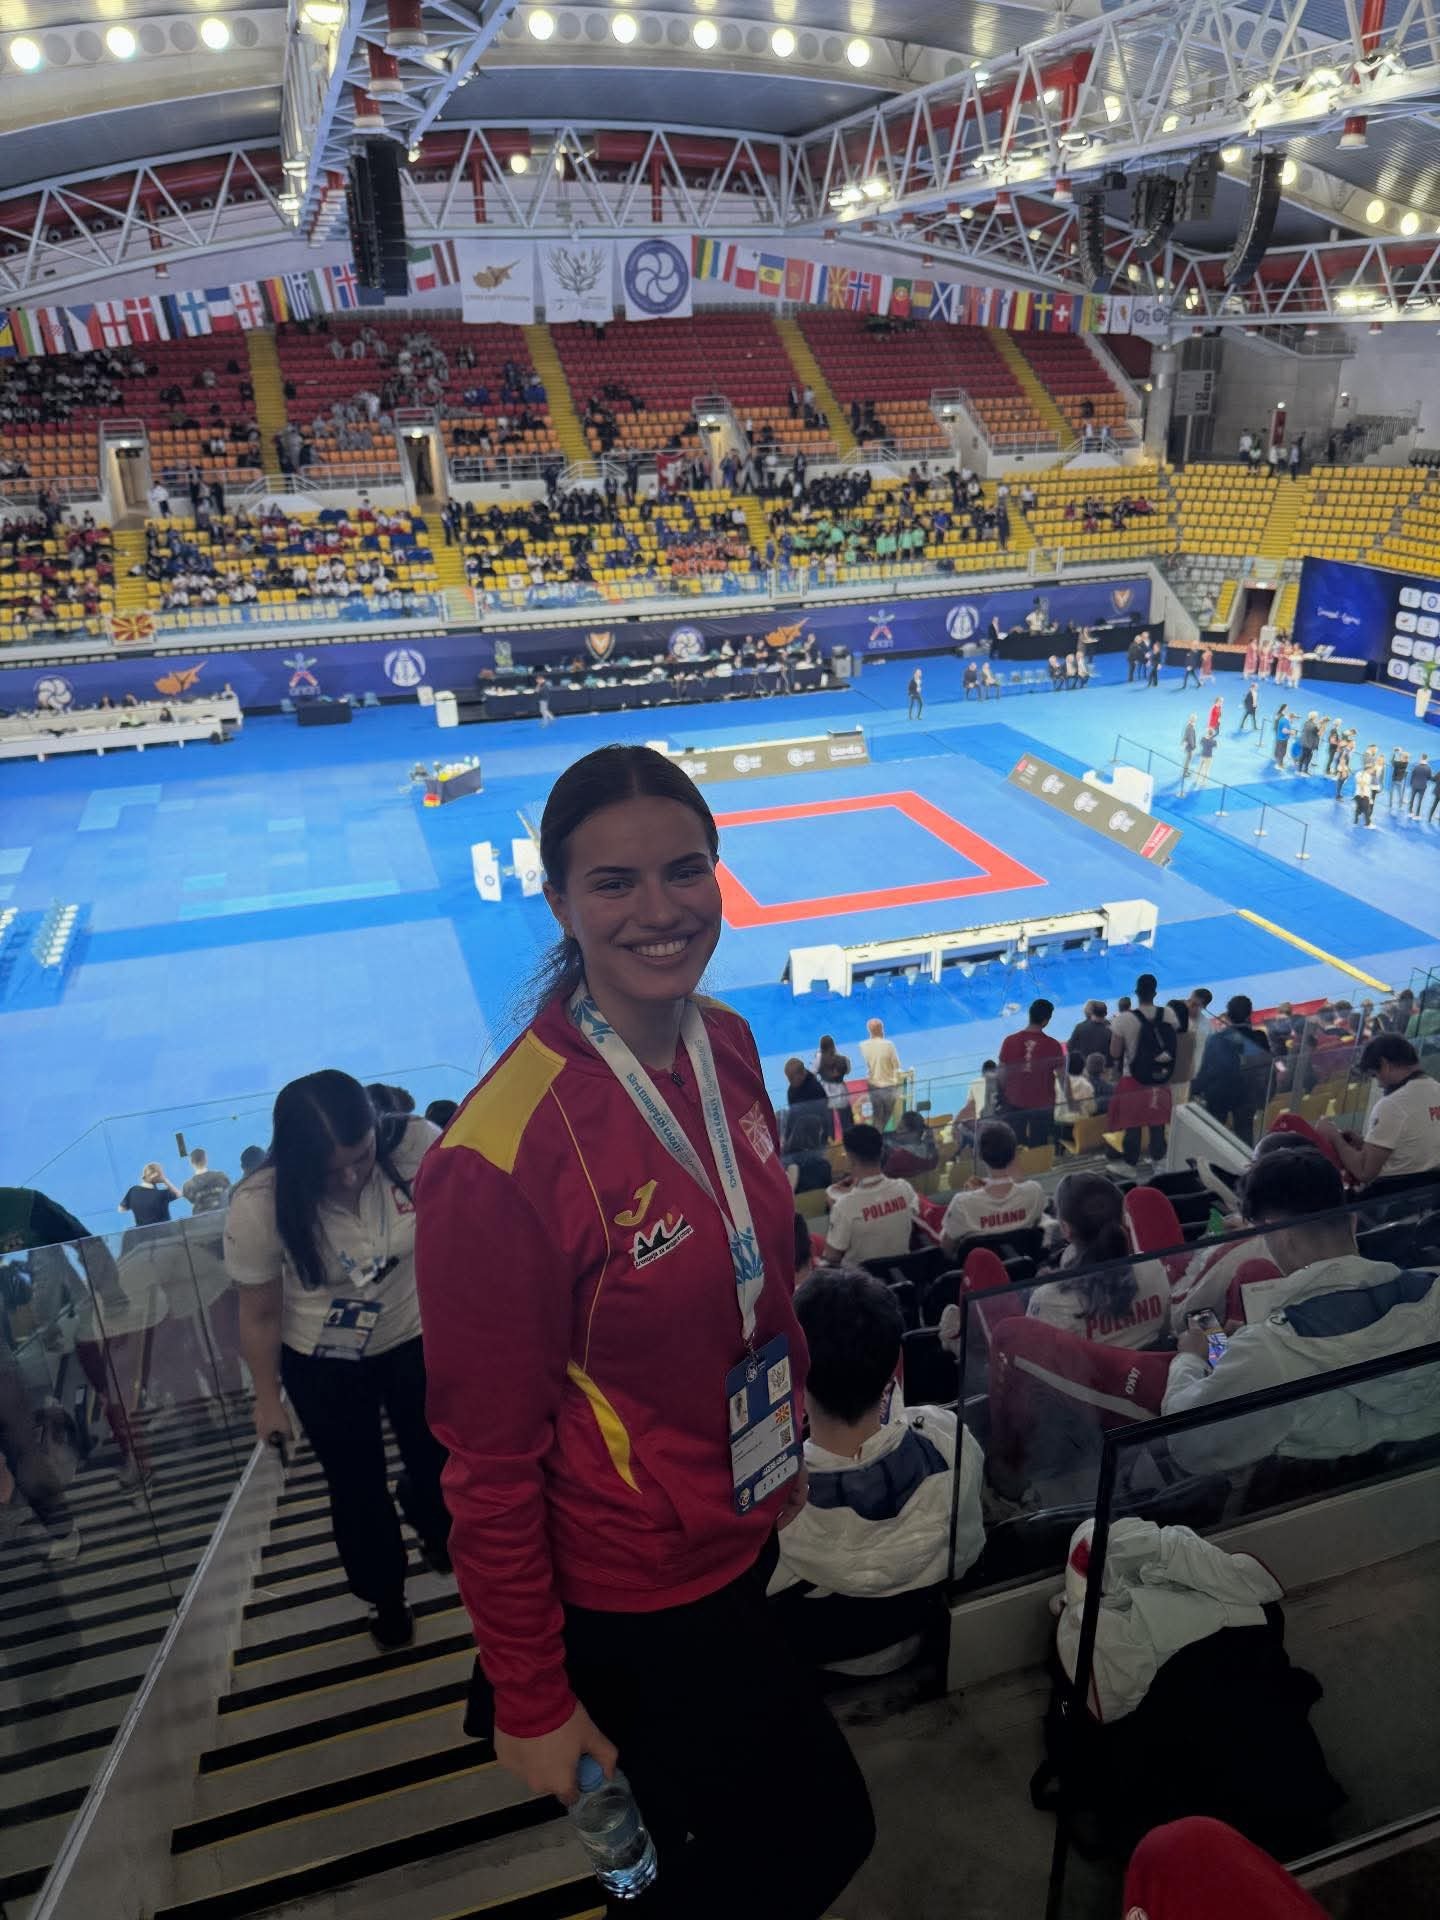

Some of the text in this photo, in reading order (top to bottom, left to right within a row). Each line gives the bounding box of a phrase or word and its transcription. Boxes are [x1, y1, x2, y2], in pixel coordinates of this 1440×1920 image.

[638, 1089, 667, 1128] EUROPEAN
[663, 1124, 684, 1153] KARATE
[862, 1195, 907, 1222] POLAND
[979, 1208, 1026, 1229] POLAND
[1124, 1366, 1141, 1395] JAKO
